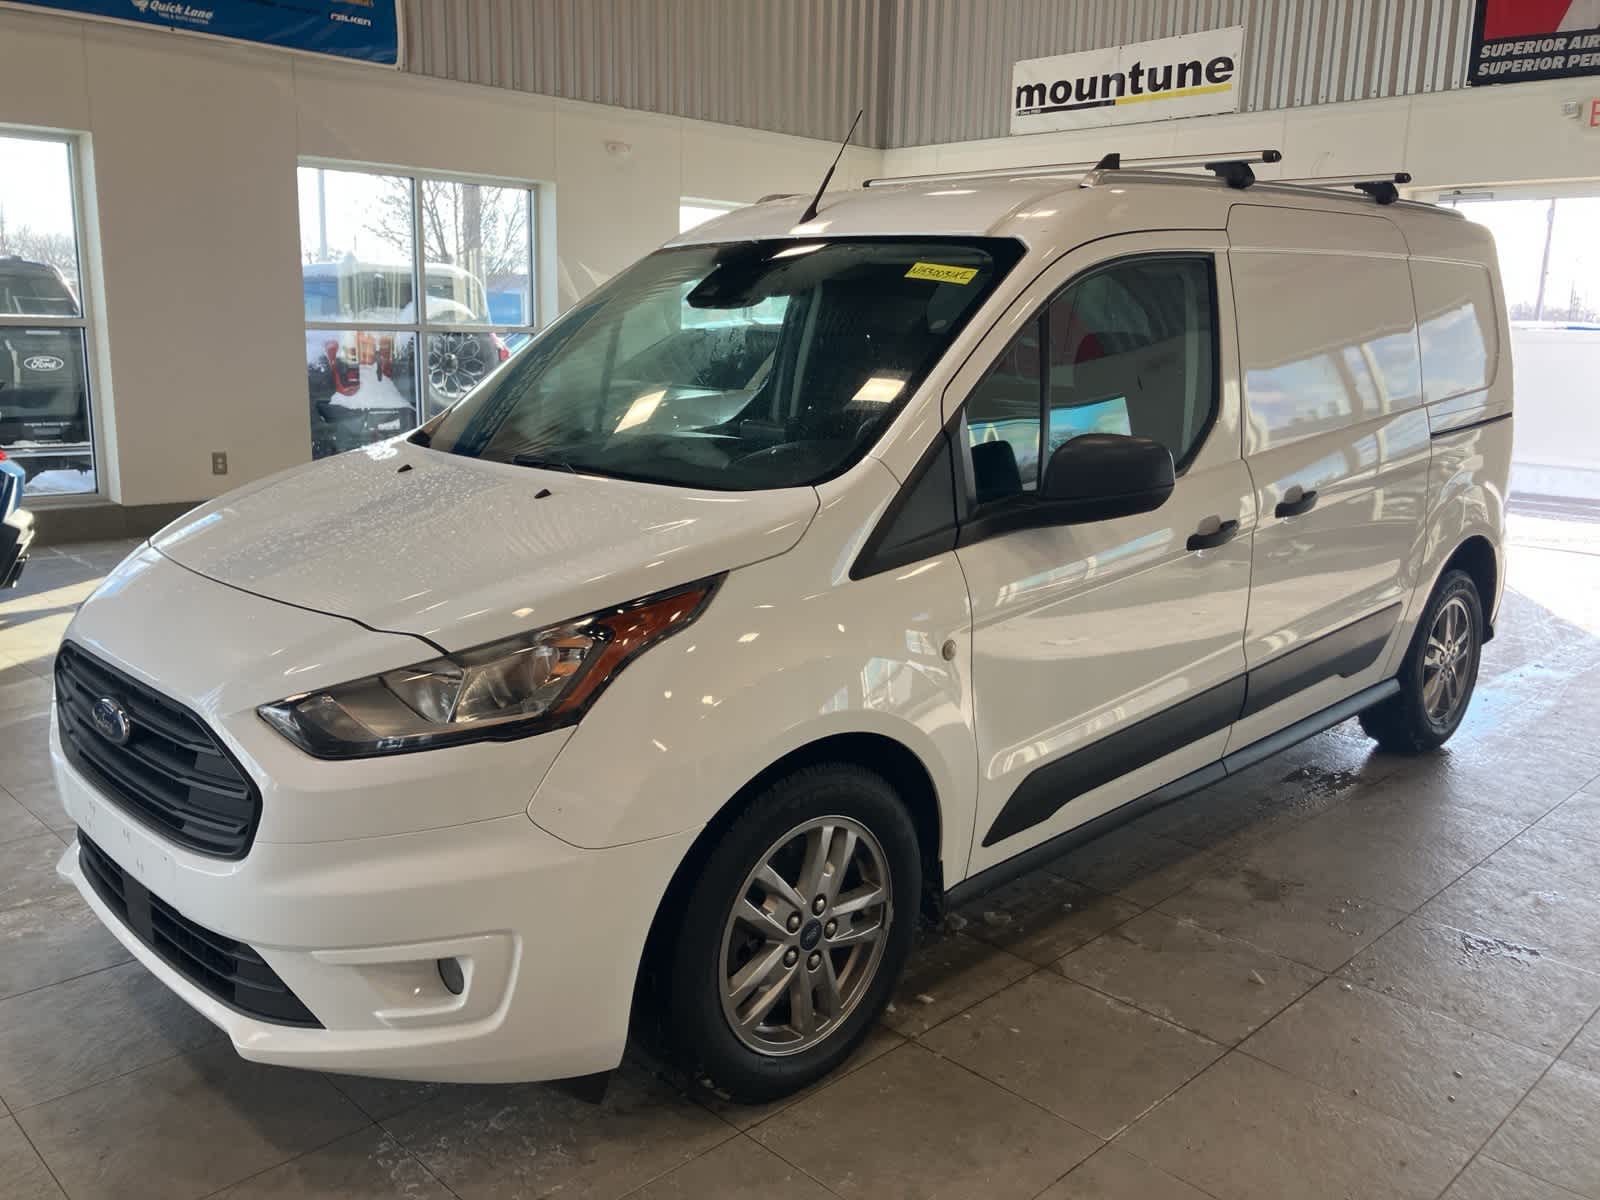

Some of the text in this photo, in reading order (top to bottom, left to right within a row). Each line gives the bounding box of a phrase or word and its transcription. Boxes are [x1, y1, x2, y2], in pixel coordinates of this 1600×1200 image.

[150, 0, 184, 14] Quick
[184, 5, 214, 19] Lane
[1479, 37, 1568, 59] SUPERIOR
[1477, 55, 1566, 76] SUPERIOR
[1015, 56, 1235, 109] mountune
